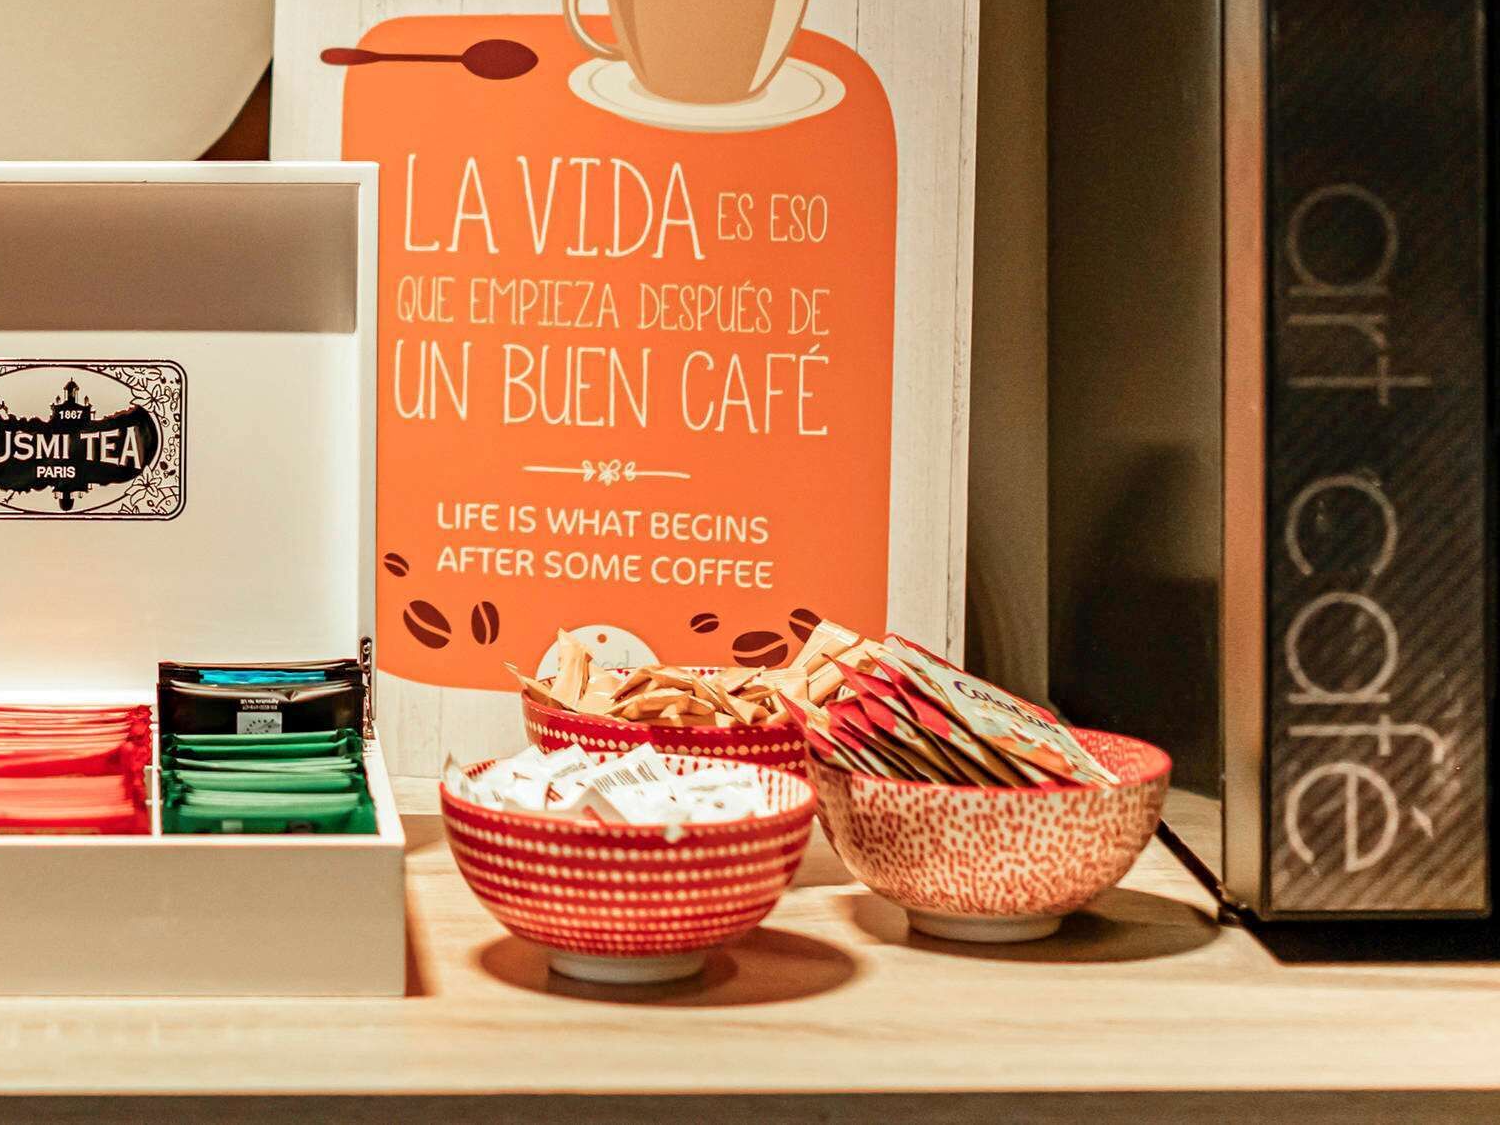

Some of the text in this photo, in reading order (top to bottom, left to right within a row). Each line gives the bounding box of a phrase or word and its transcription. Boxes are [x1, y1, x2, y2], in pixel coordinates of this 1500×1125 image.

[403, 153, 828, 260] LA VIDA ES ESO
[397, 275, 830, 336] QUE EMPIEZA DESPUÉS DE
[394, 339, 829, 435] UN BUEN CAFÉ
[58, 409, 83, 420] 1867
[80, 426, 141, 470] TEA
[36, 465, 76, 478] PARIS
[437, 502, 769, 545] LIFE IS WHAT BEGINS
[1285, 183, 1446, 874] art café
[437, 546, 773, 589] AFTER SOME COFFEE
